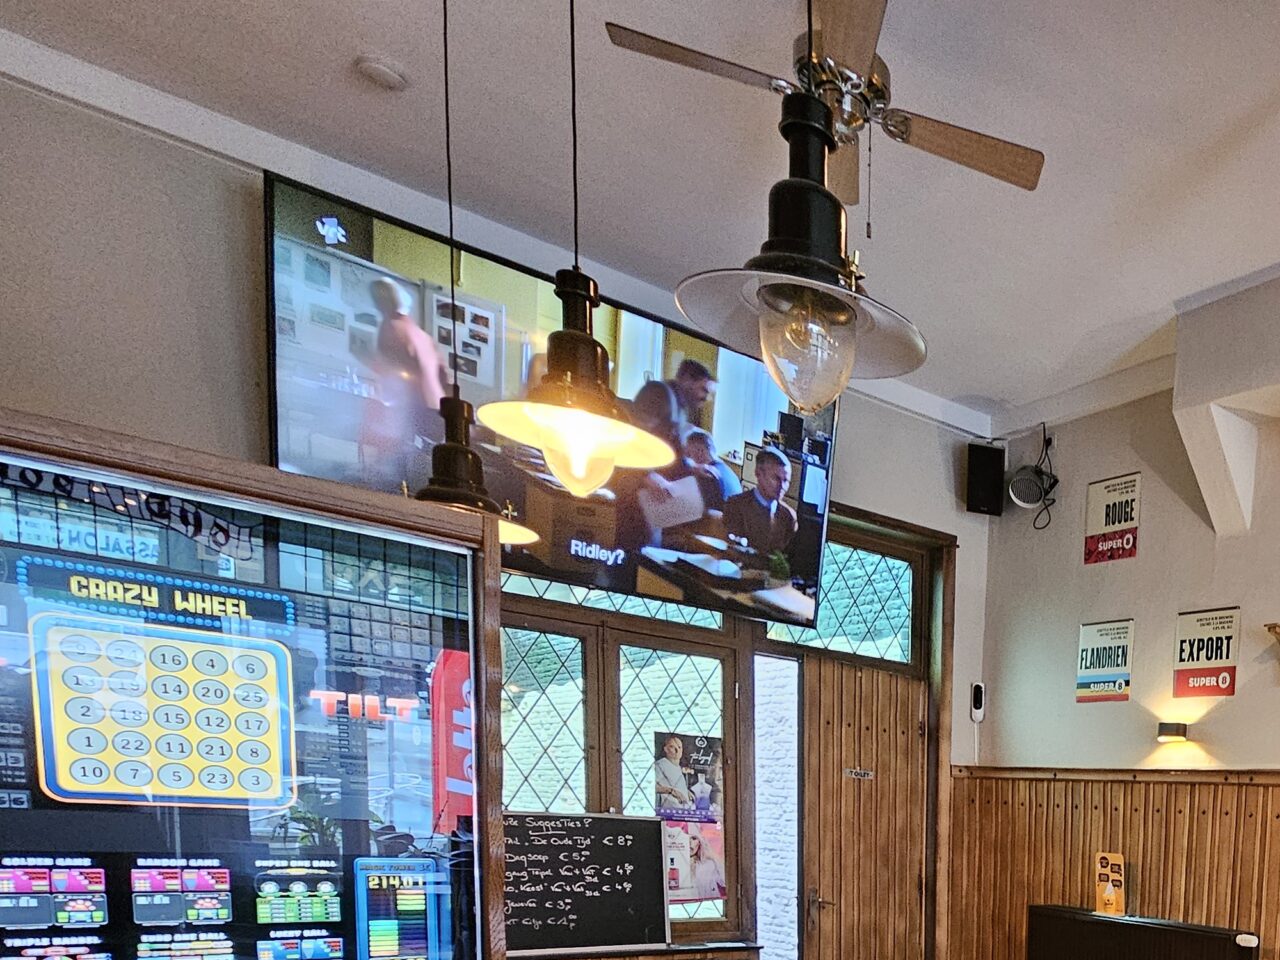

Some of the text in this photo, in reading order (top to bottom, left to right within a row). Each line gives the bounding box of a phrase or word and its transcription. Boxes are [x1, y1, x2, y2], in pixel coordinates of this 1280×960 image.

[1104, 498, 1136, 527] ROUGE
[570, 539, 625, 566] Ridley?
[1098, 539, 1123, 551] SUPER
[69, 575, 252, 620] CRAZY WHEEL
[1079, 644, 1128, 670] FLANDRIEN
[1178, 635, 1233, 663] EXPORT
[160, 652, 182, 667] 16
[206, 658, 216, 670] 4
[246, 662, 256, 675] 6
[161, 683, 183, 696] 14
[202, 686, 224, 700] 20
[242, 689, 264, 703] 25
[1090, 681, 1117, 691] SUPER
[1188, 676, 1217, 687] SUPER
[80, 704, 264, 731] 2 18 15 12 17
[310, 690, 420, 721] TILT
[85, 735, 260, 759] 1 22 11 21 8
[80, 765, 261, 787] 10 7 5 23 3
